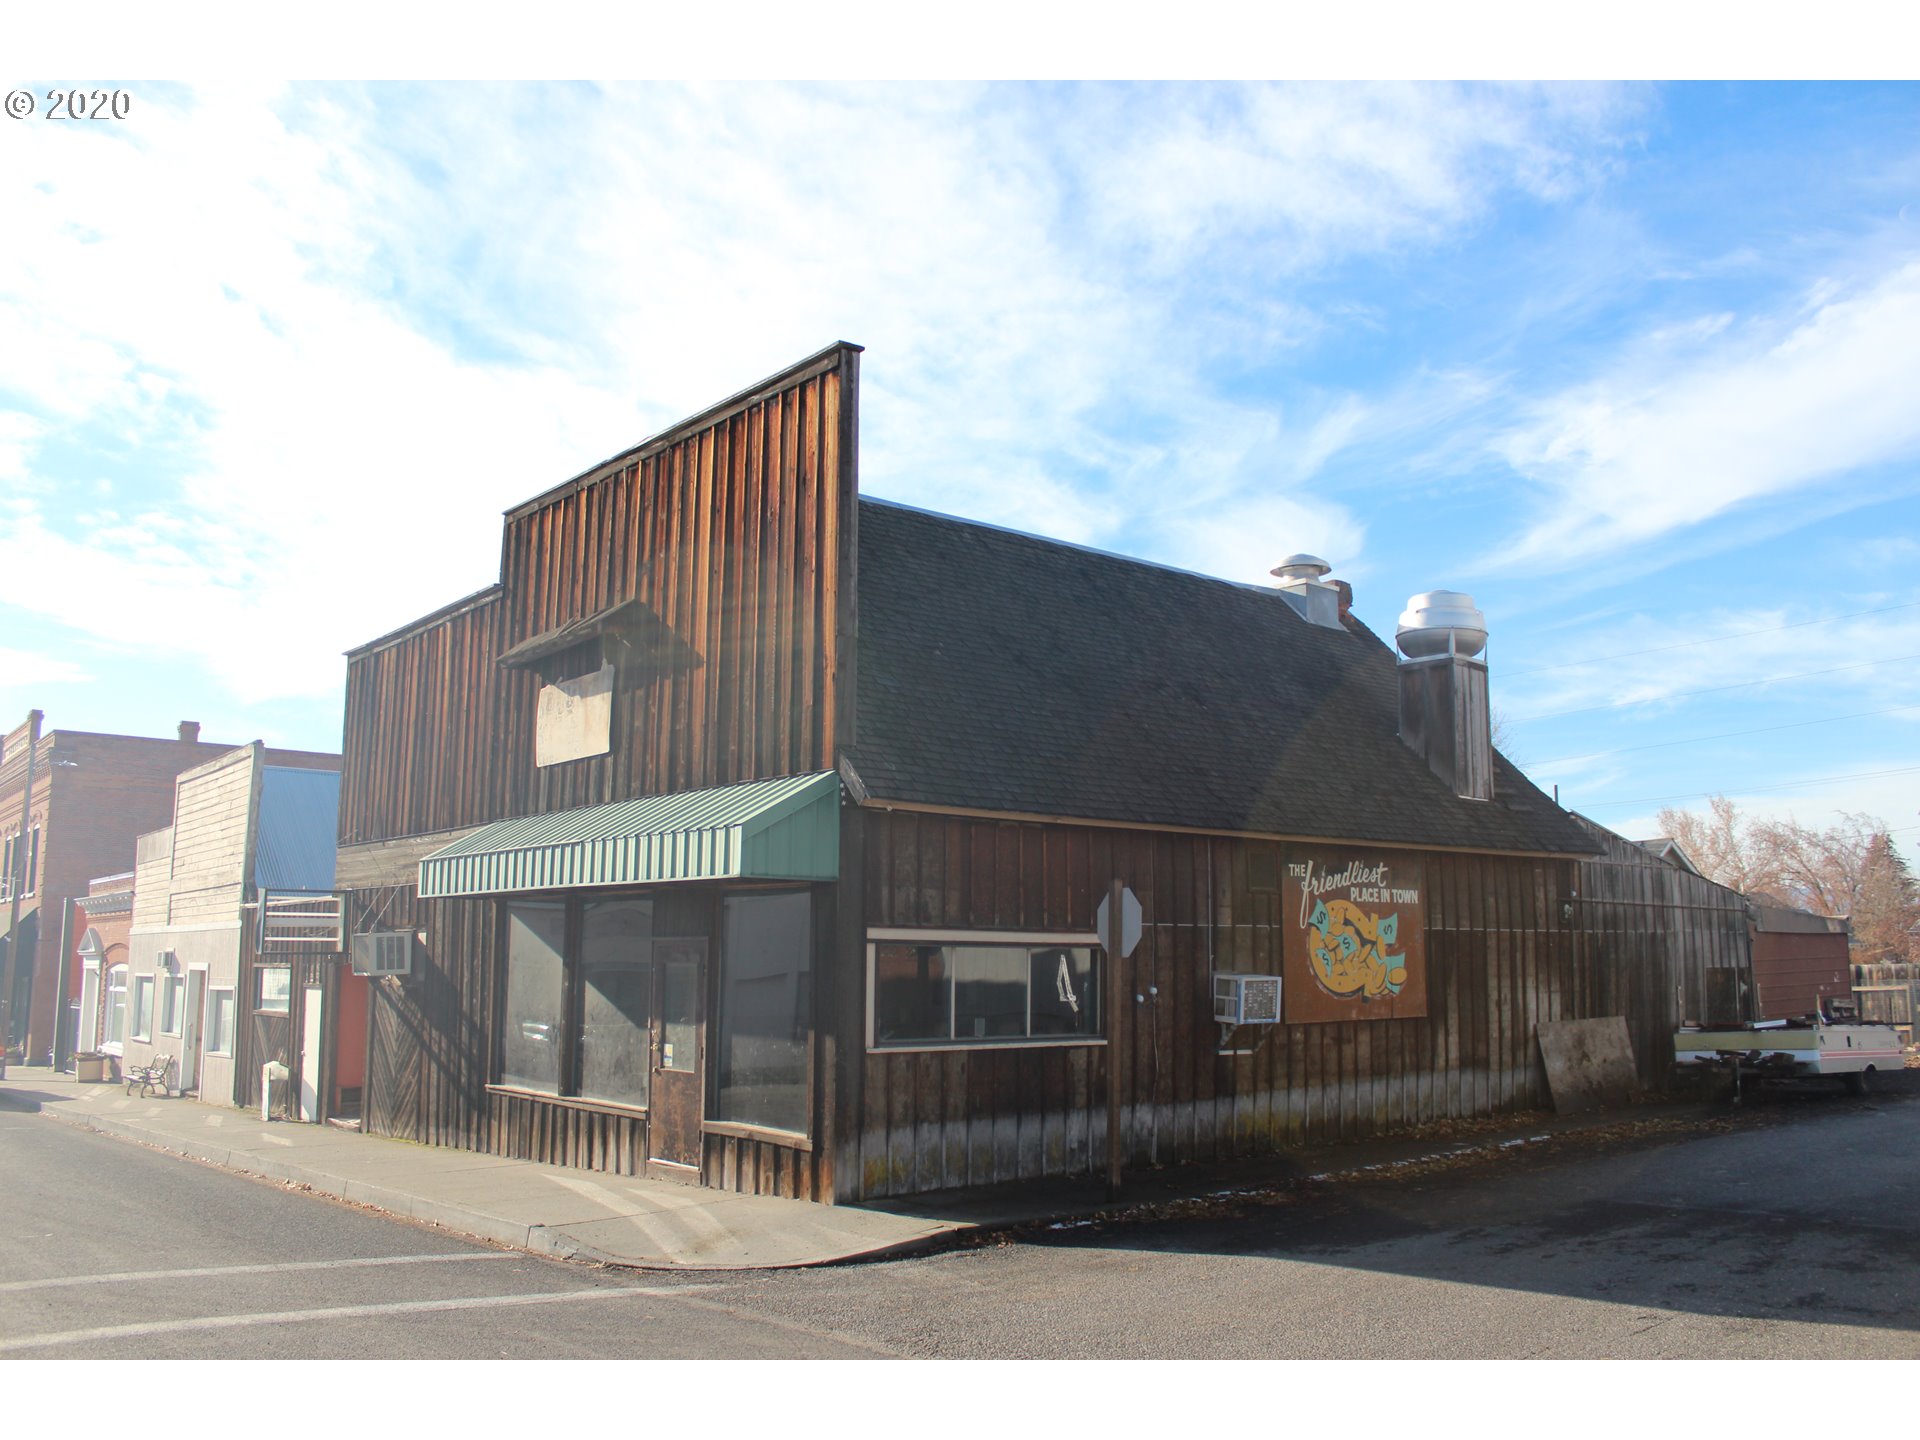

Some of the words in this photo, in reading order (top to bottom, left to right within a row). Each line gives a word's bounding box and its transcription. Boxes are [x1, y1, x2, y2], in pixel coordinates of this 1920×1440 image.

[1289, 864, 1306, 877] THE
[1300, 860, 1388, 929] friendliest
[1350, 887, 1379, 902] PLACE
[1380, 888, 1391, 903] IN
[1392, 889, 1419, 904] TOWN
